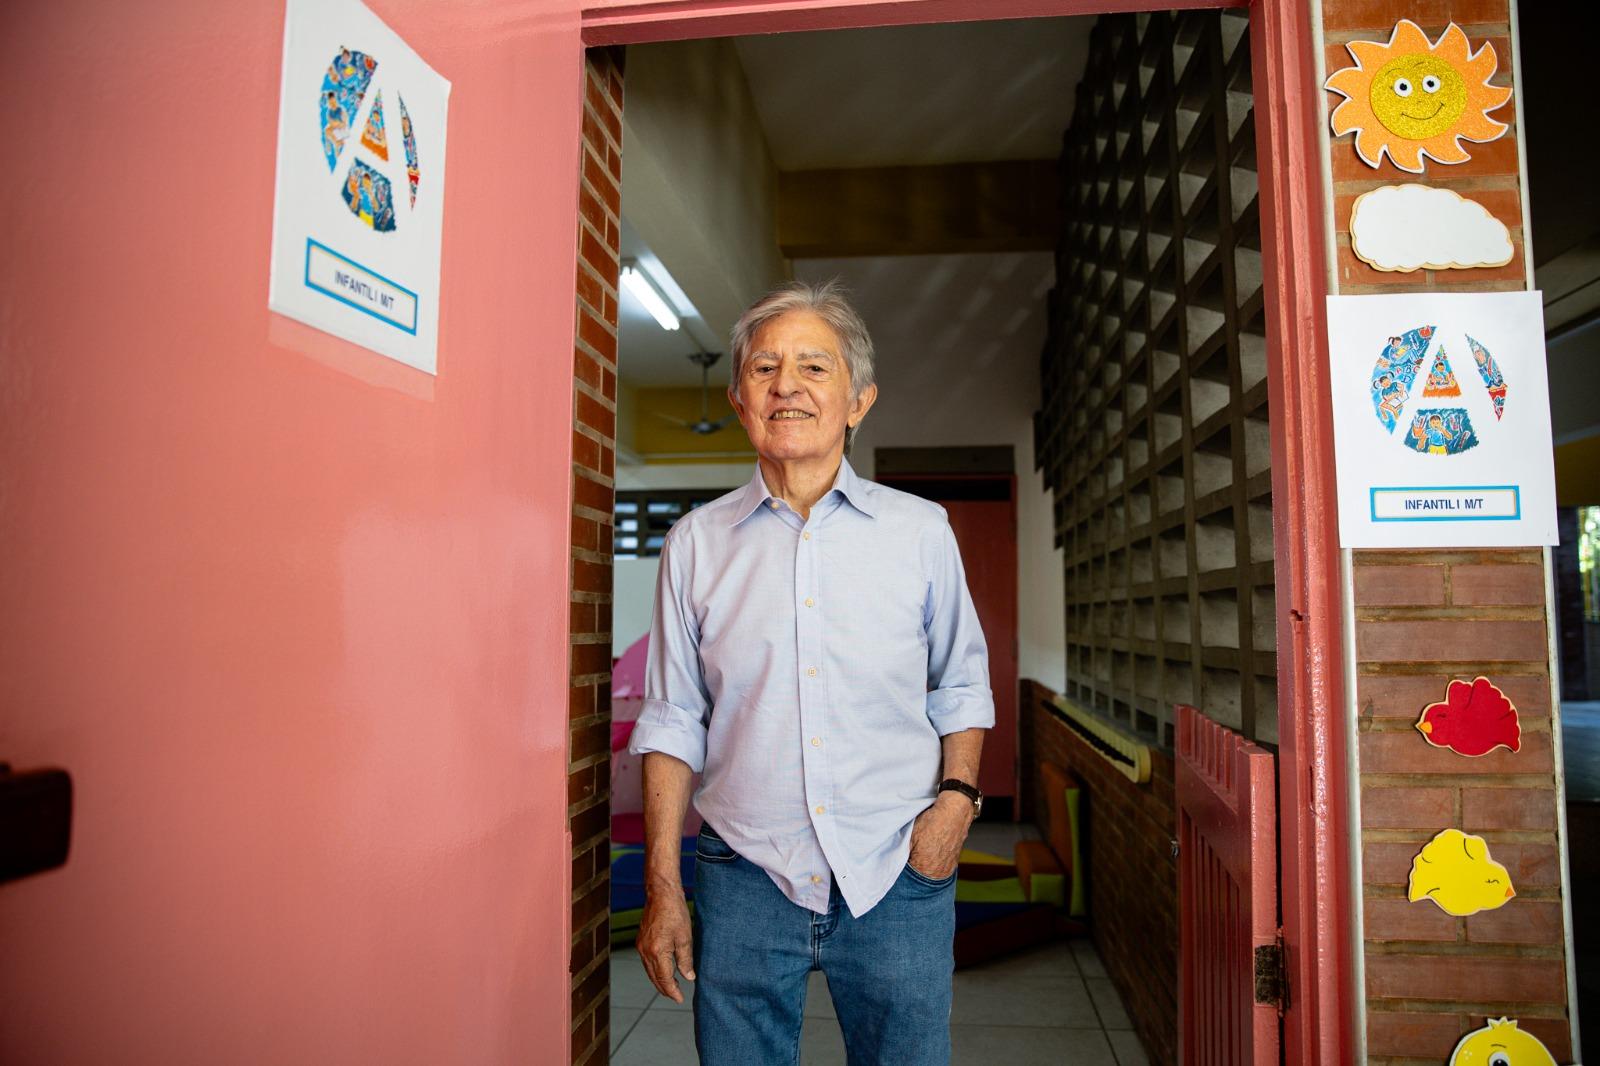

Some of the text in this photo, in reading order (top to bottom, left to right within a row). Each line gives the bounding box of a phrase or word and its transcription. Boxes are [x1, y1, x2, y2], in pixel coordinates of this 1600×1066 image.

[334, 270, 374, 301] INFANTIL
[1404, 499, 1455, 510] INFANTIL
[1464, 498, 1484, 509] M/T
